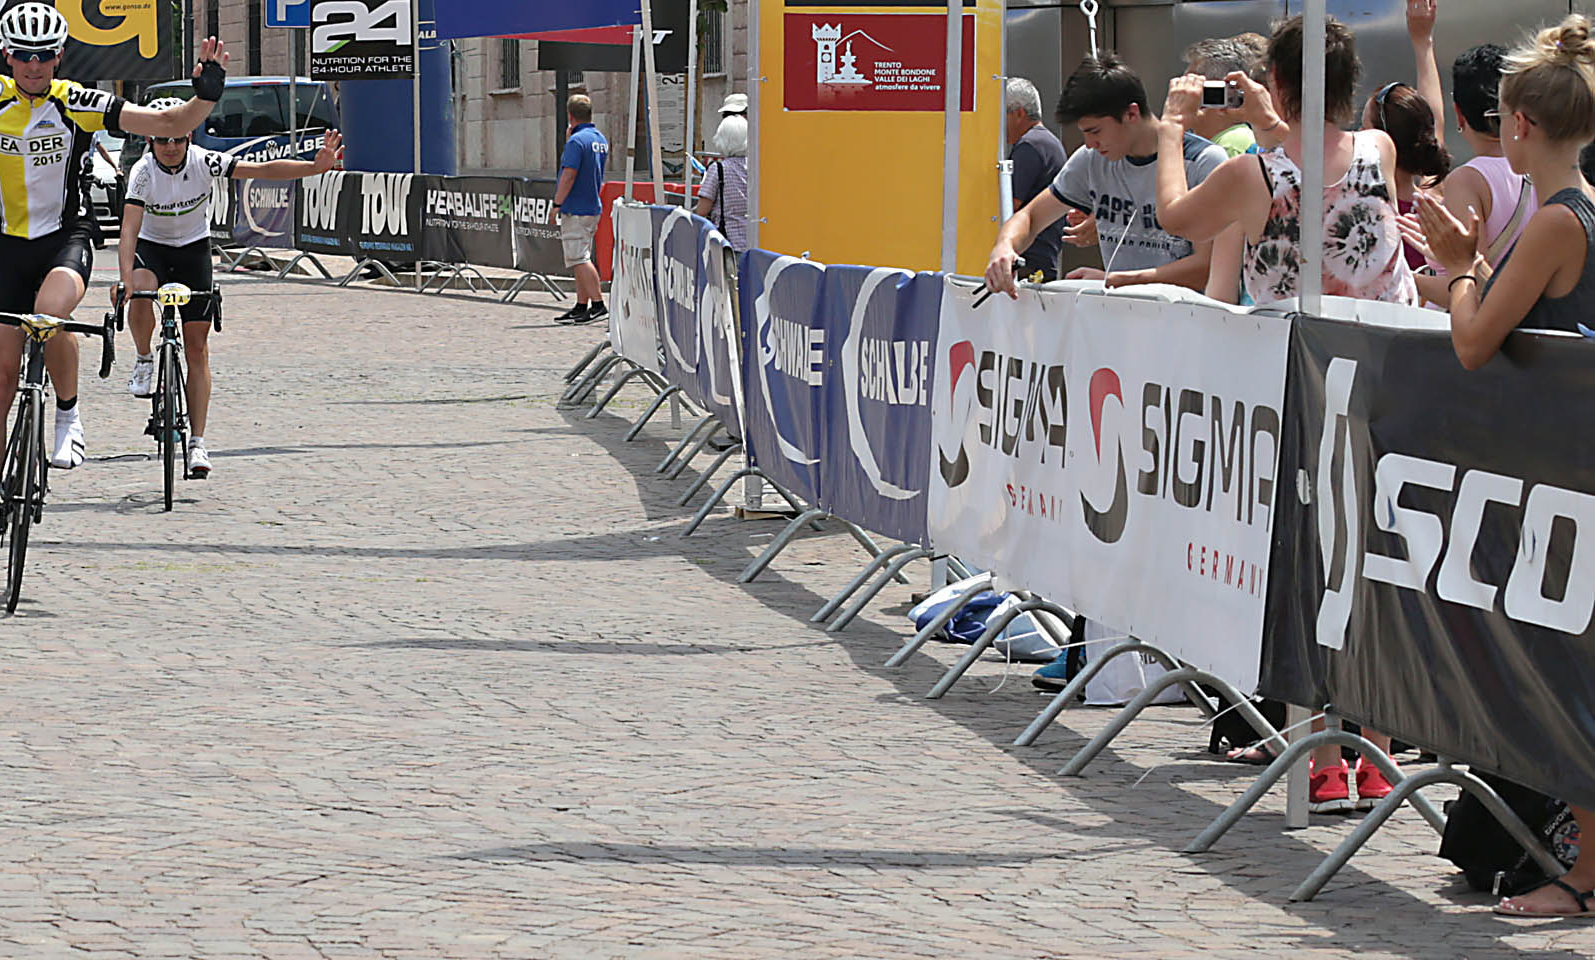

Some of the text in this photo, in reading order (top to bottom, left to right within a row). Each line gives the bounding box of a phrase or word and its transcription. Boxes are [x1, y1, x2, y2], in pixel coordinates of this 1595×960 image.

[312, 0, 412, 53] 24
[312, 56, 366, 65] NUTRITION
[368, 56, 389, 64] FOR
[312, 64, 412, 74] 24-HOUR ATHLETE
[32, 154, 63, 166] 2015
[165, 293, 176, 303] 21
[1137, 382, 1280, 533] SIGMA
